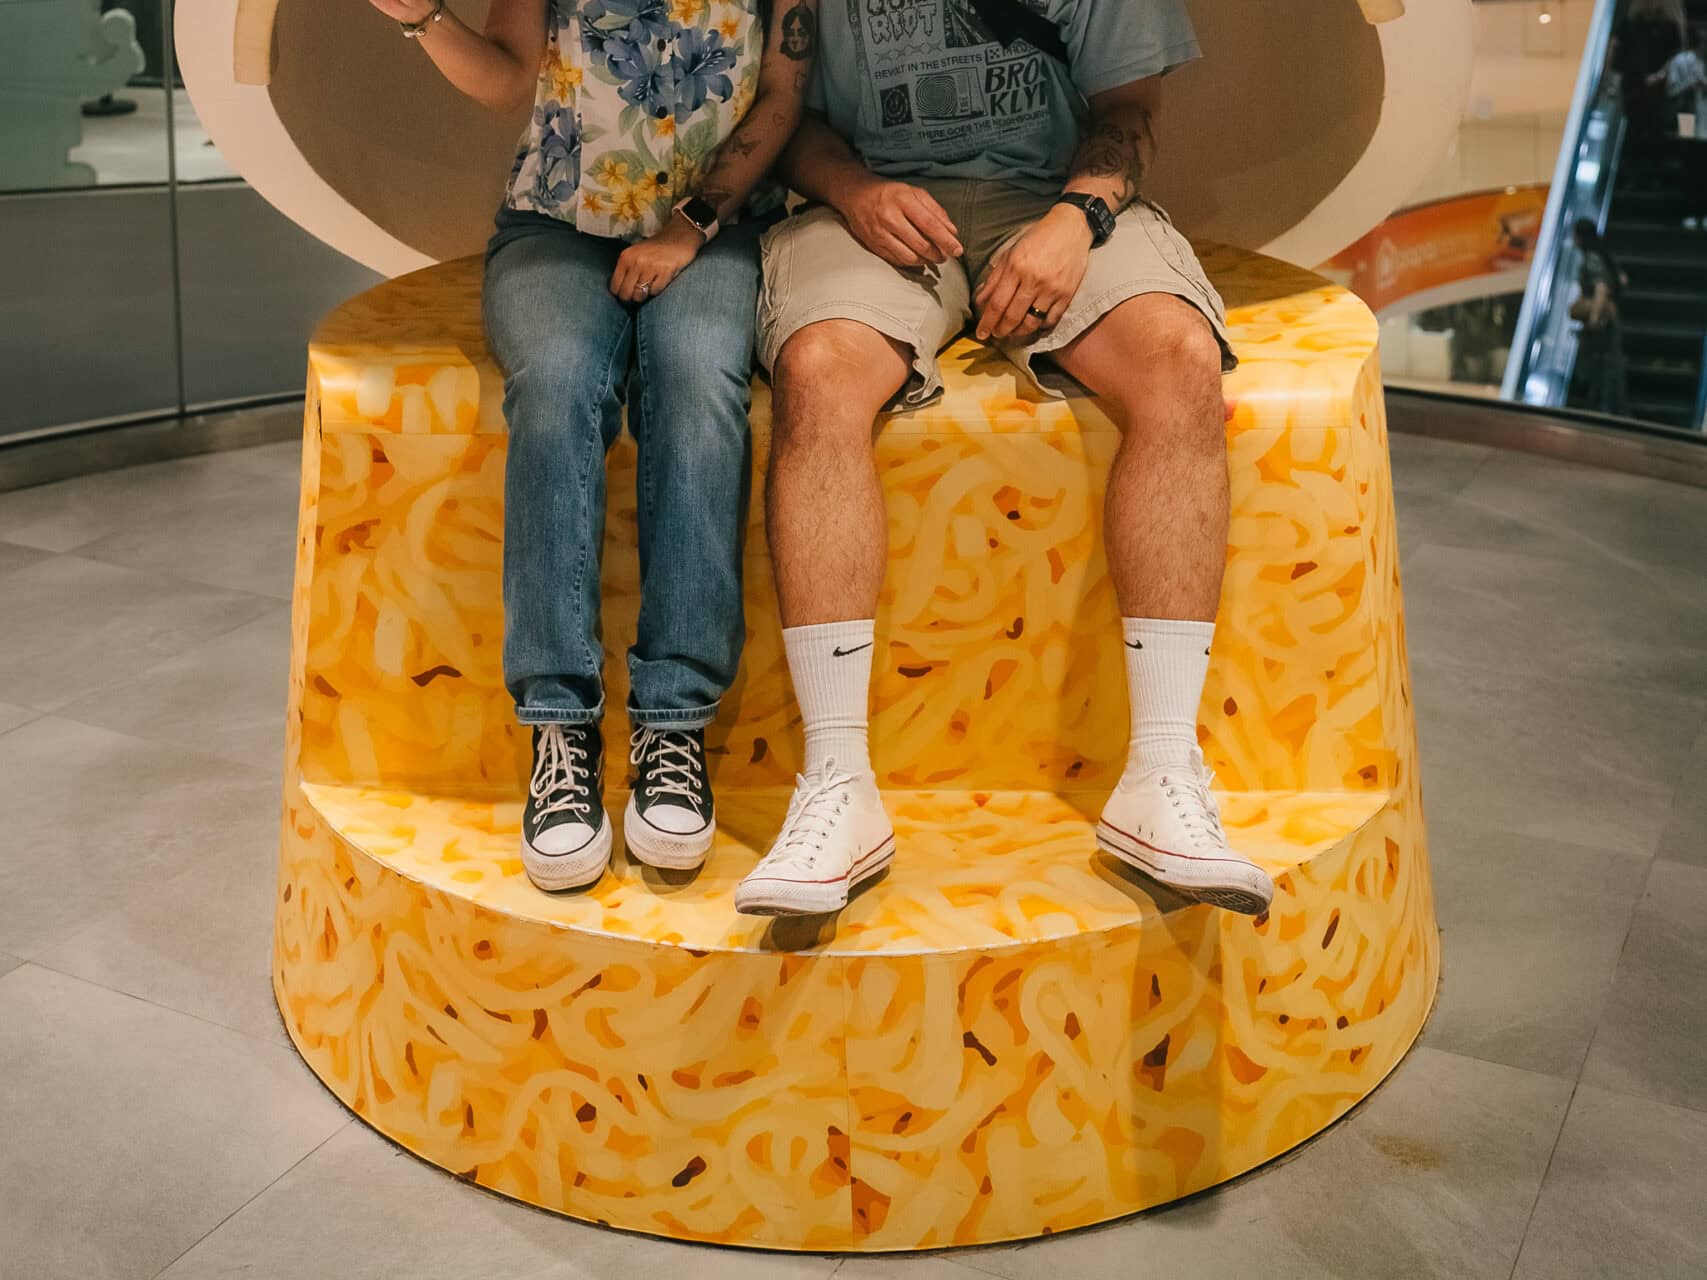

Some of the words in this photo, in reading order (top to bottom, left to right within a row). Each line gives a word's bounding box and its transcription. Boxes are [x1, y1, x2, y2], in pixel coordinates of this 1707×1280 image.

[868, 3, 937, 45] RIOT
[908, 62, 918, 72] IN
[920, 59, 939, 70] THE
[940, 54, 983, 68] STREETS
[918, 128, 946, 140] THERE
[947, 123, 972, 136] GOES
[974, 119, 991, 131] THE
